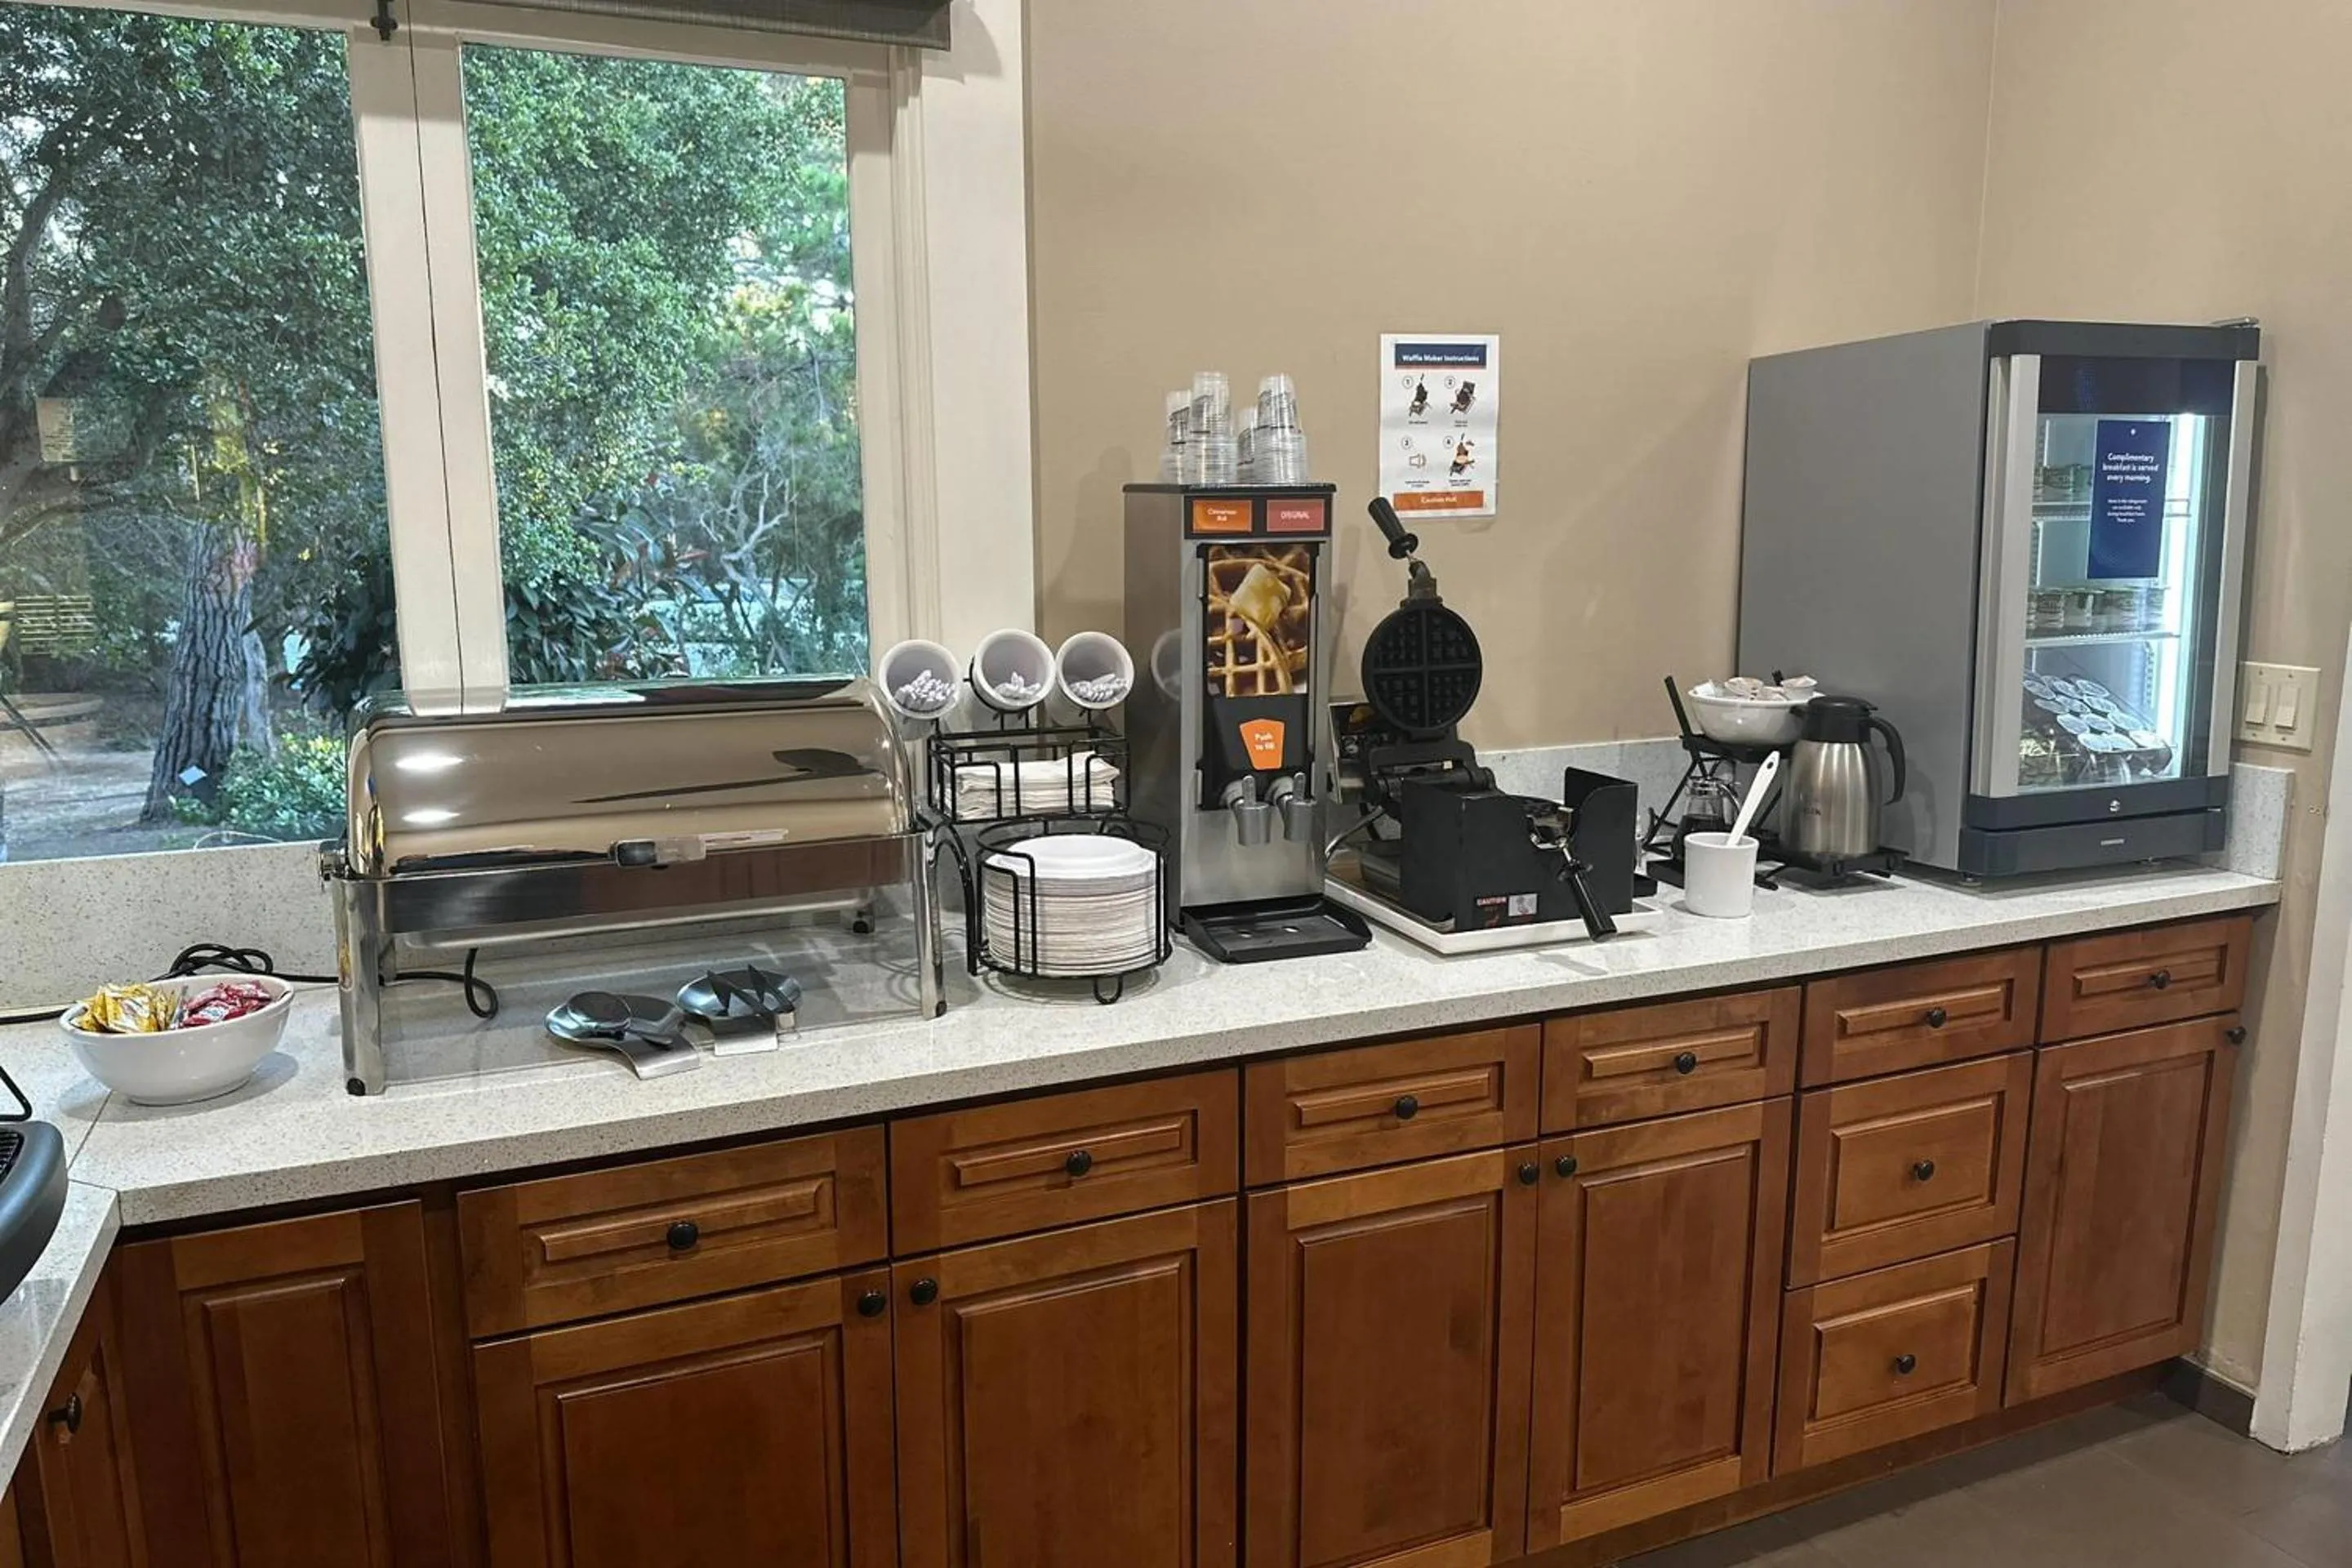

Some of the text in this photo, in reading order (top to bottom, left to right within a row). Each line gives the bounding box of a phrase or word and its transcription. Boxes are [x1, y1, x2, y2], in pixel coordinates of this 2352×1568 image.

[2108, 452, 2154, 464] Complimentary
[2103, 463, 2131, 471] breakfast
[2138, 464, 2160, 472] served
[2107, 474, 2123, 484] every
